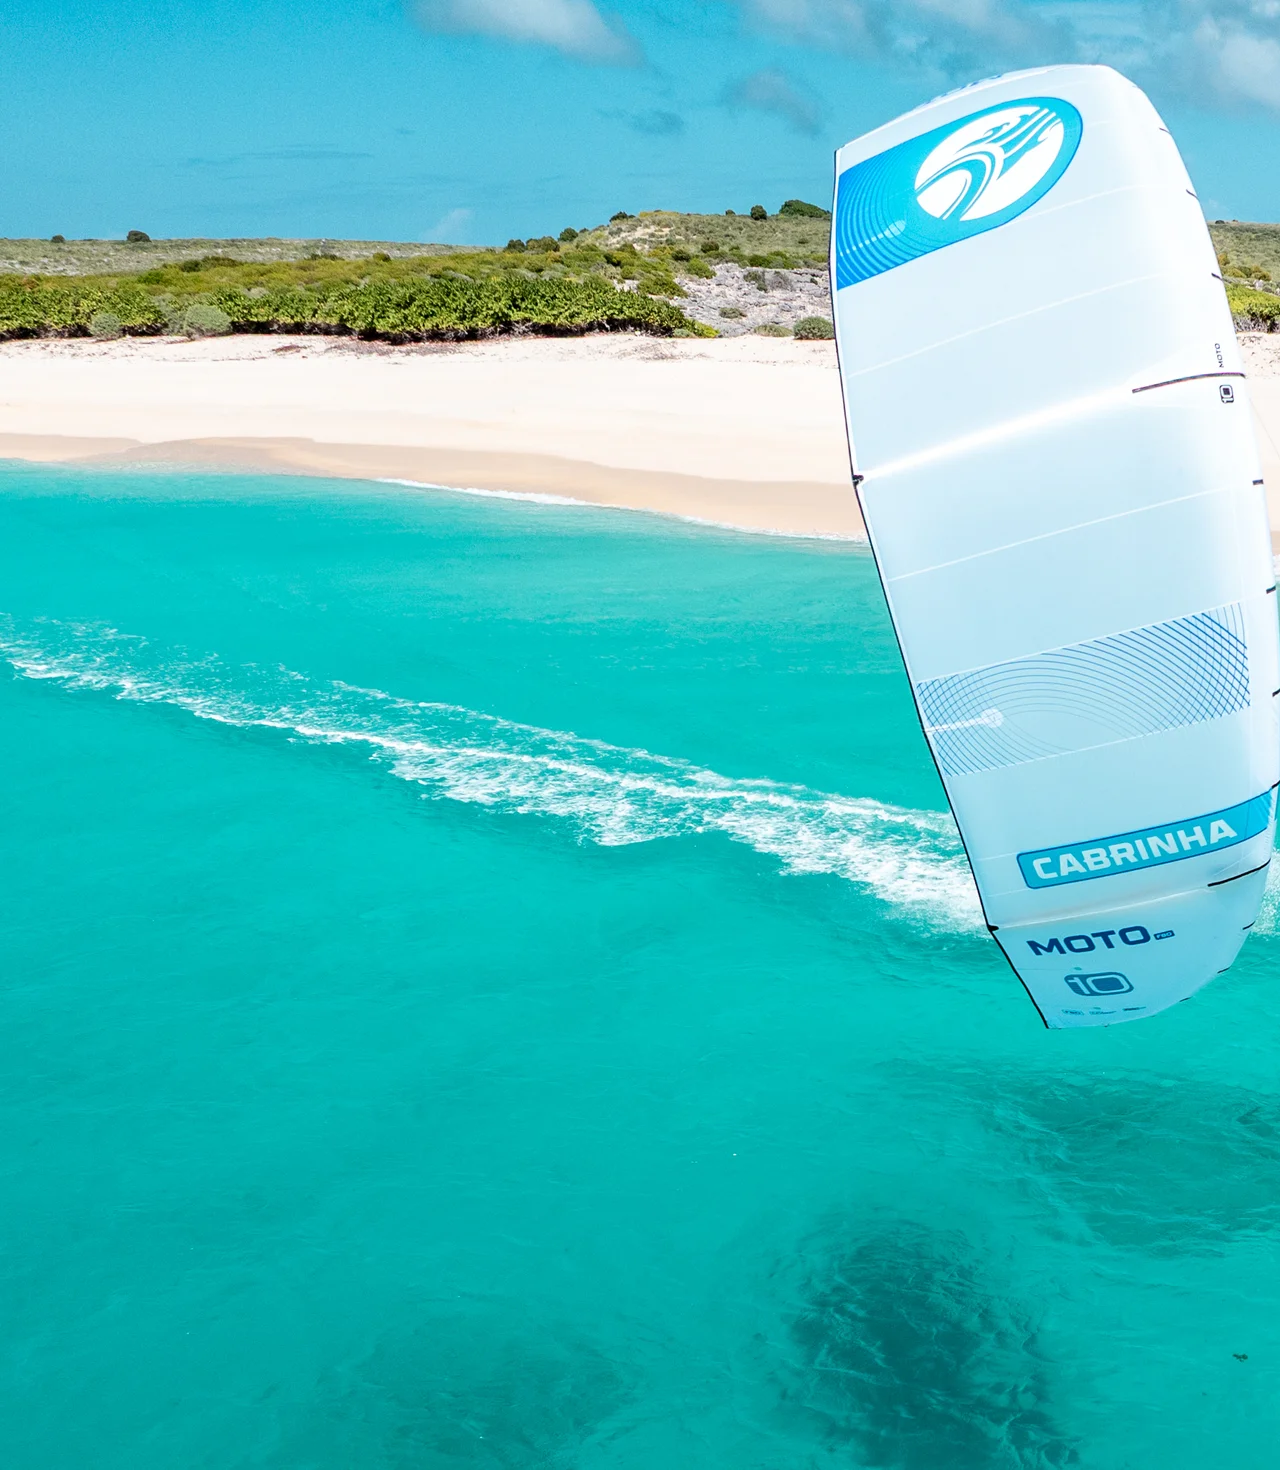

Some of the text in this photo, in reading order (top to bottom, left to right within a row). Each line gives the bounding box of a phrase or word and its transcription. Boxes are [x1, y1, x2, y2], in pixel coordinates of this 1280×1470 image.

[1032, 818, 1237, 880] CABRINHA
[1026, 925, 1151, 956] MOTO
[1067, 974, 1131, 995] 10
